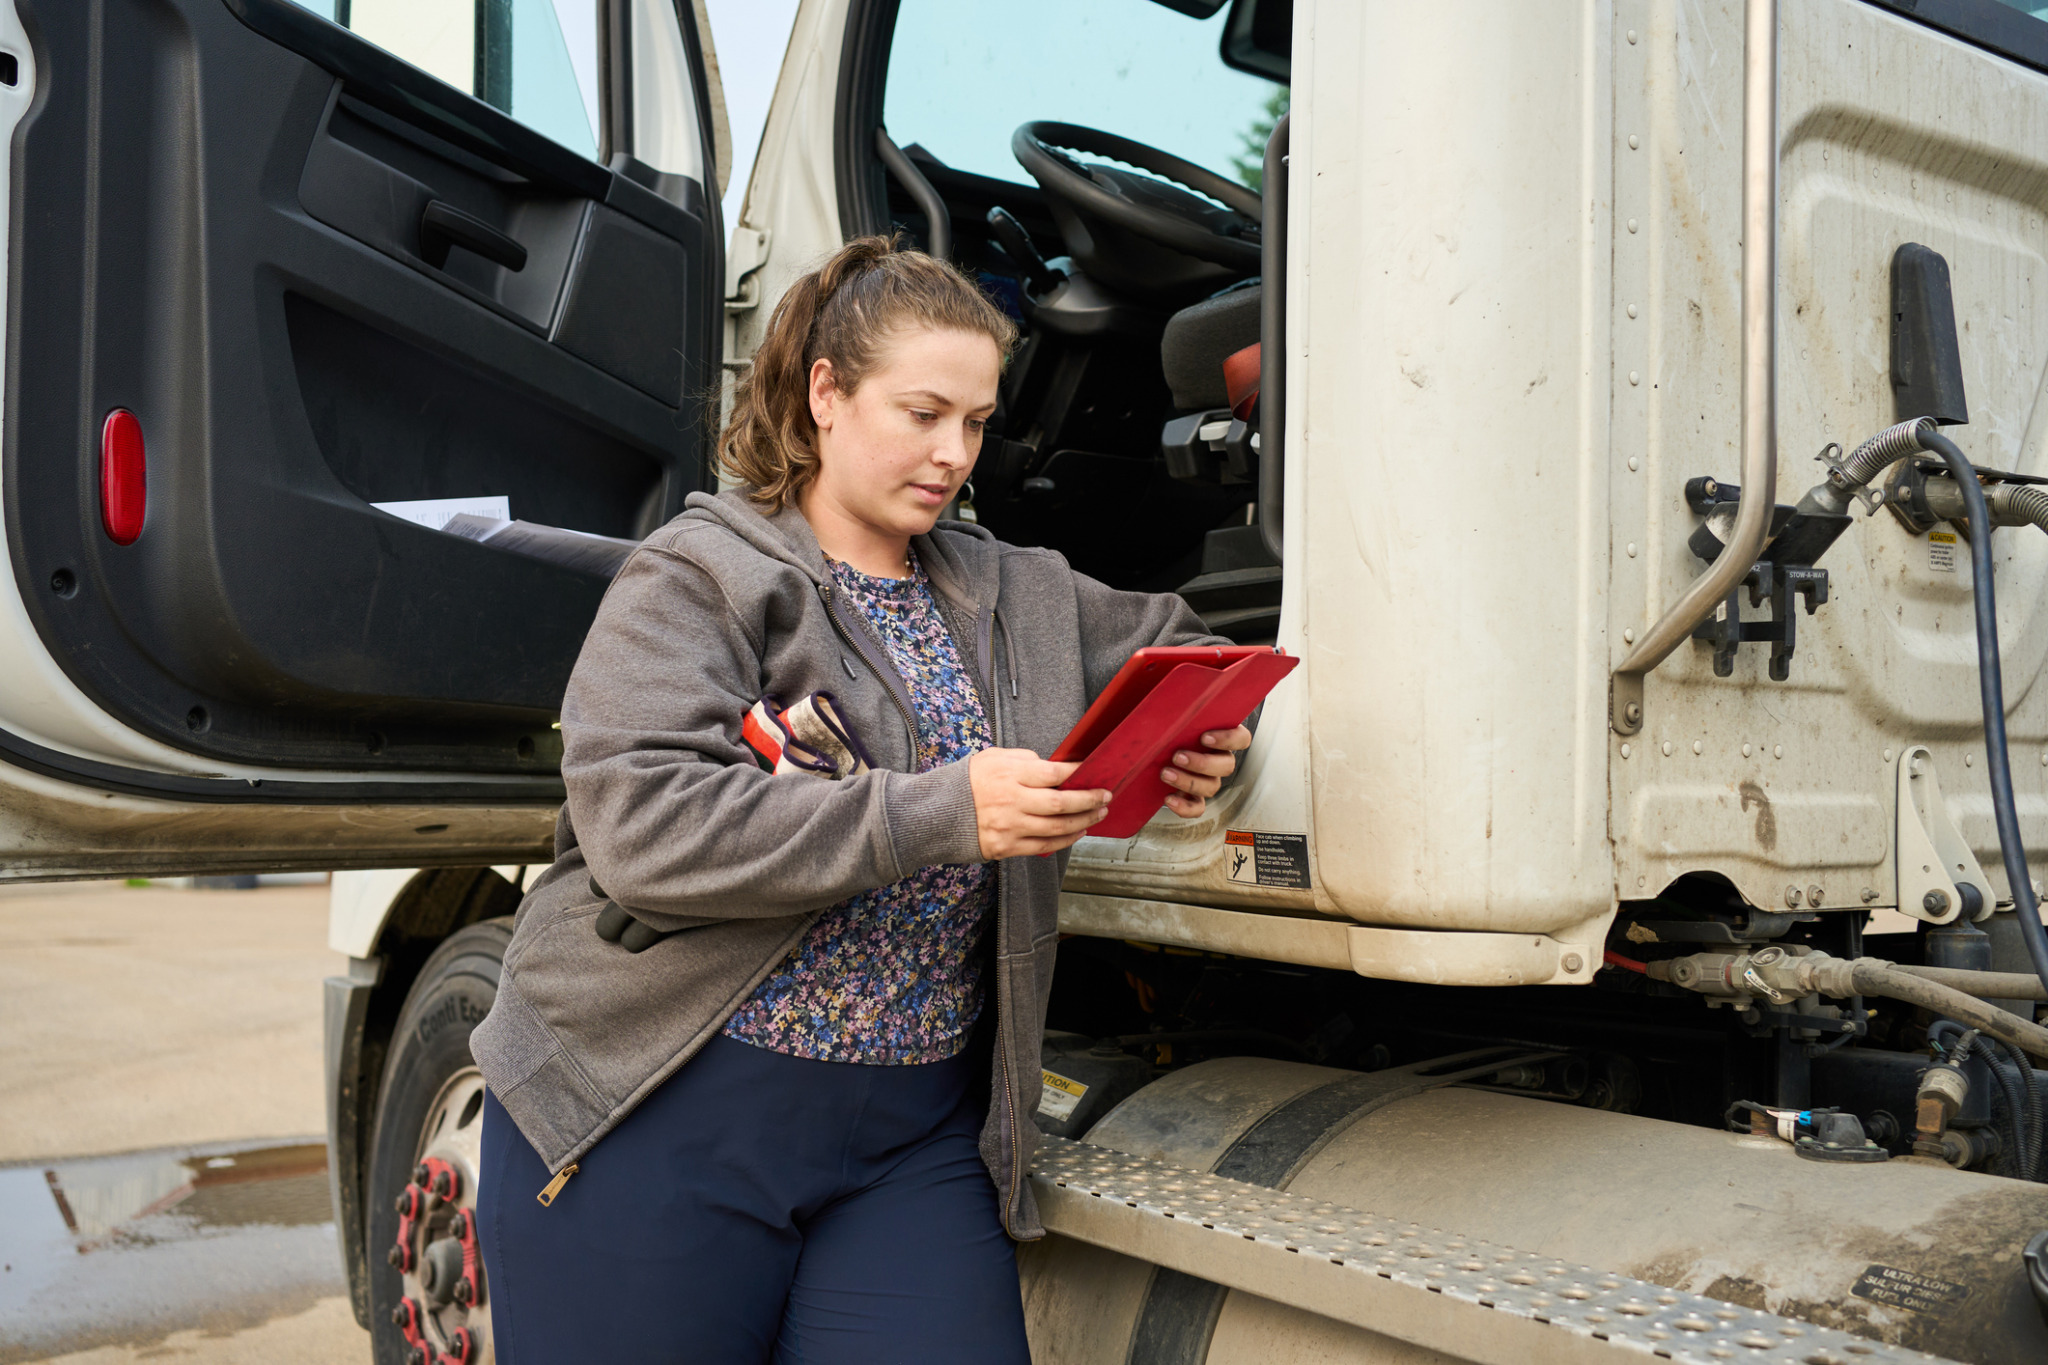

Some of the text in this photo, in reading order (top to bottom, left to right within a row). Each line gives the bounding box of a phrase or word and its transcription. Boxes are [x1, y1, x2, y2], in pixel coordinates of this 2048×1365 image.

[1230, 833, 1252, 843] WARNING
[420, 996, 456, 1042] Conti
[1042, 1074, 1070, 1090] UTION
[1883, 1269, 1953, 1292] ULTRA LOW
[1904, 1297, 1935, 1310] ONLY
